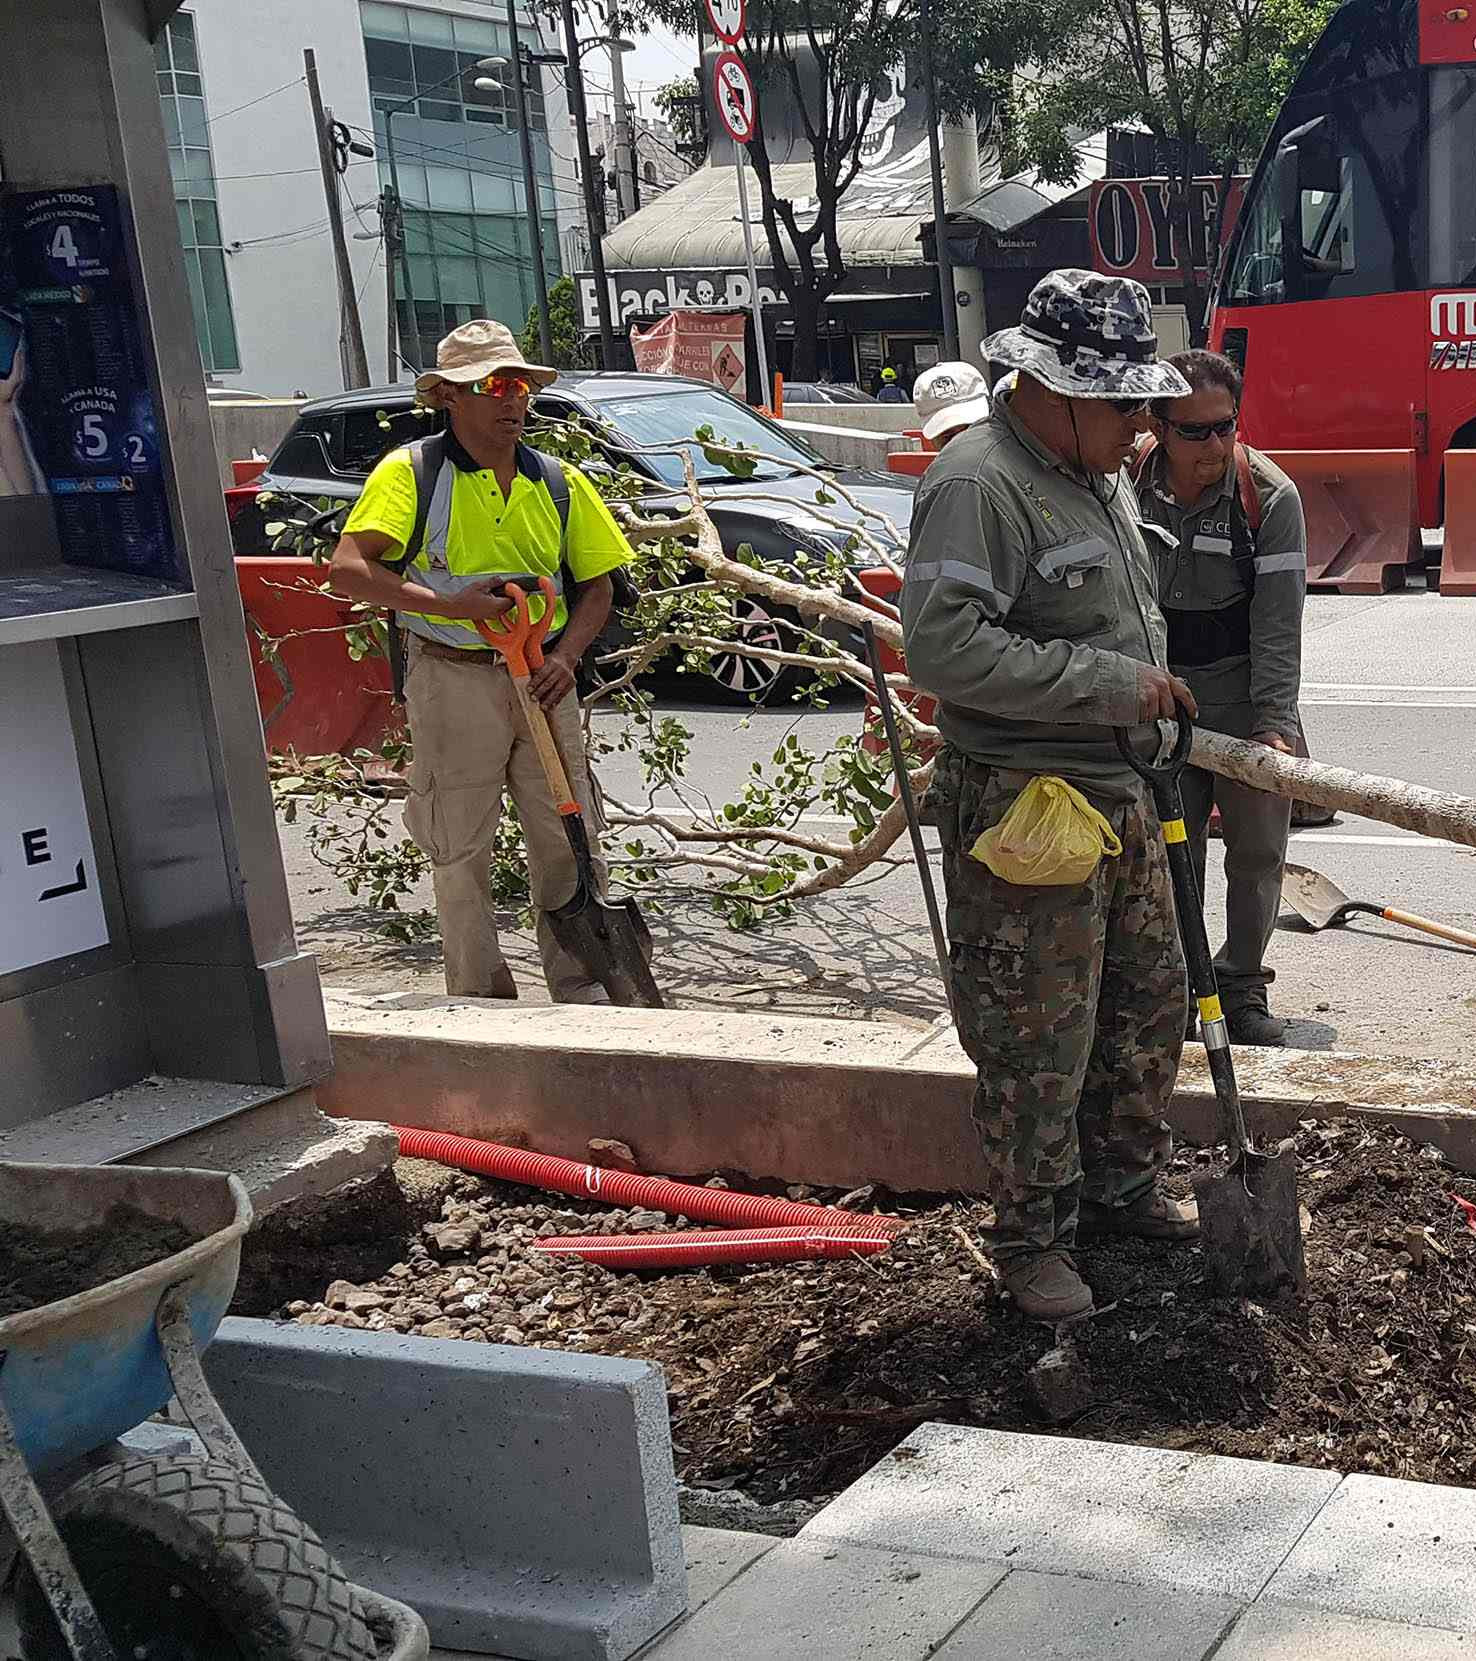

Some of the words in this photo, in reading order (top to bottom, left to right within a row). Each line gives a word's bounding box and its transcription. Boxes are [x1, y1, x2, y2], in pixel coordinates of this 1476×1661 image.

[57, 193, 96, 207] TODOS
[94, 386, 118, 400] USA
[22, 827, 52, 866] E
